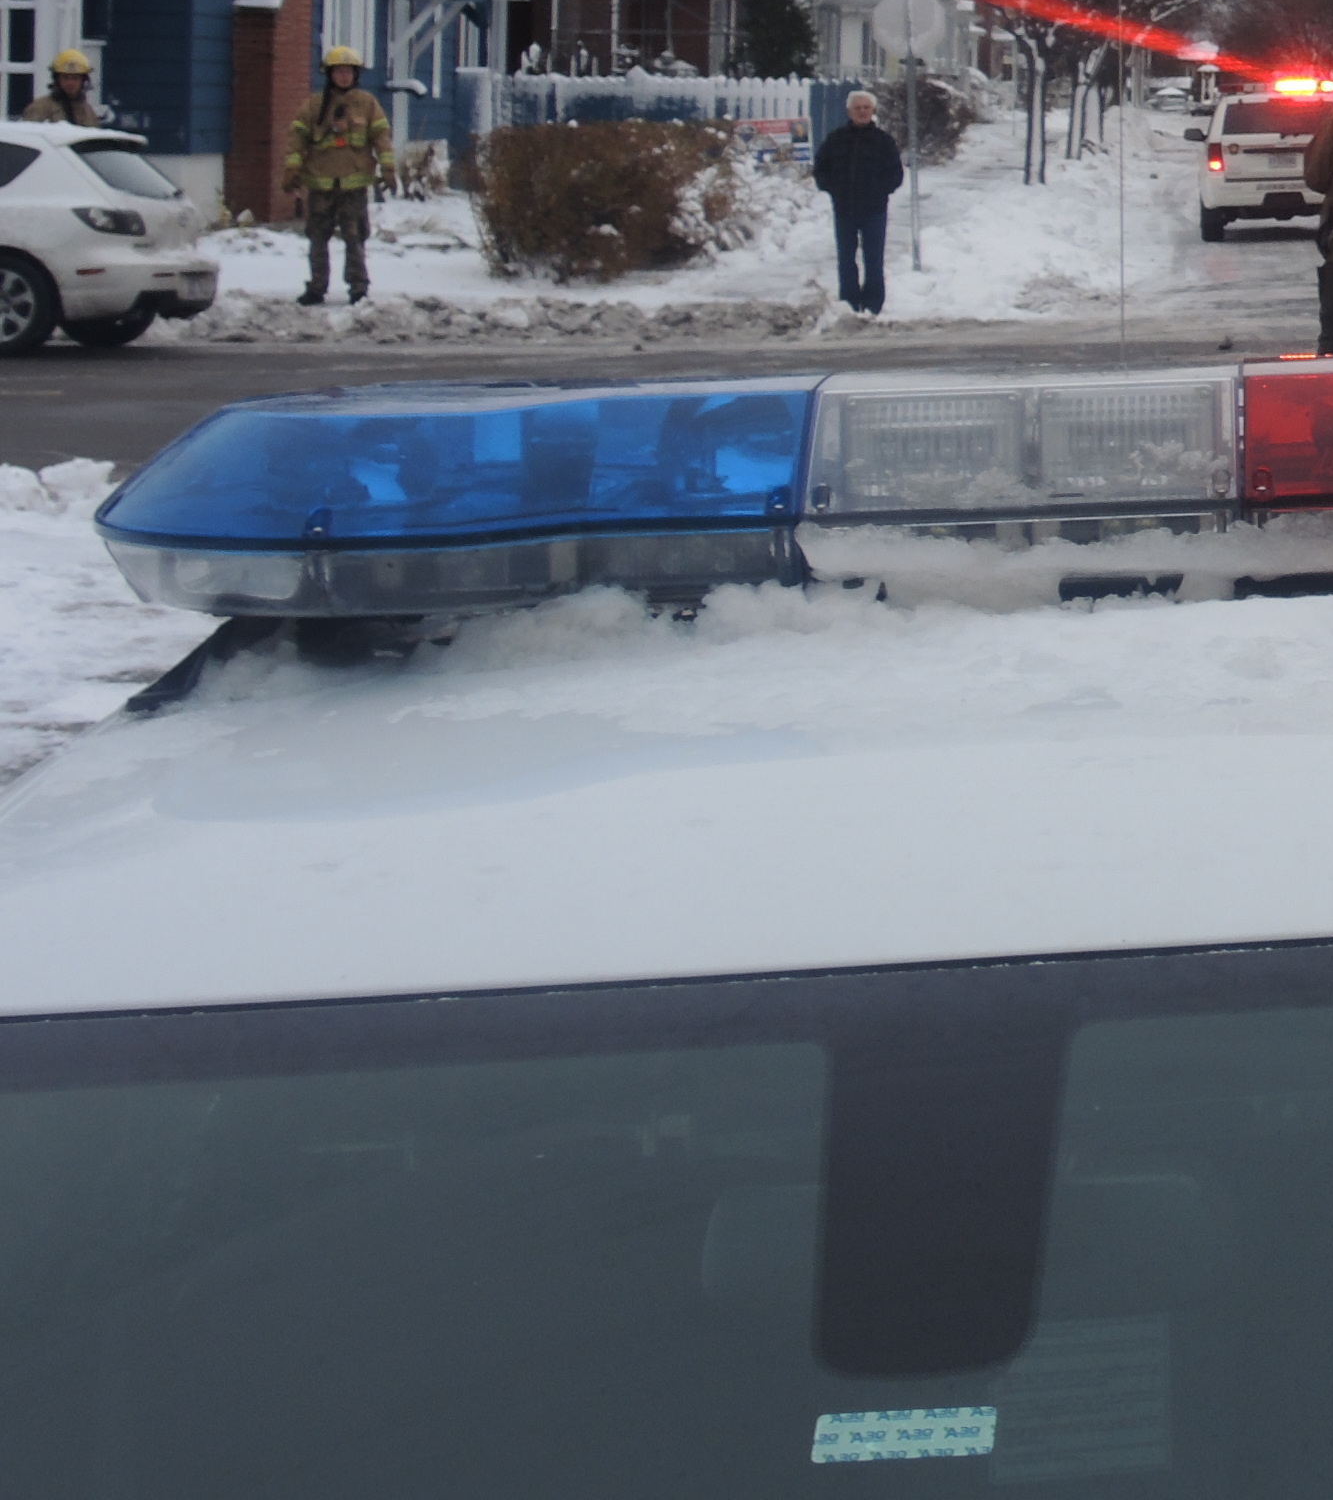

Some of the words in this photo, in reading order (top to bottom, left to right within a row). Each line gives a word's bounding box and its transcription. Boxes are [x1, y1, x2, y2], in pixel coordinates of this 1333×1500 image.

[850, 1430, 886, 1443] A30
[897, 1428, 934, 1441] A30
[944, 1426, 981, 1439] A30
